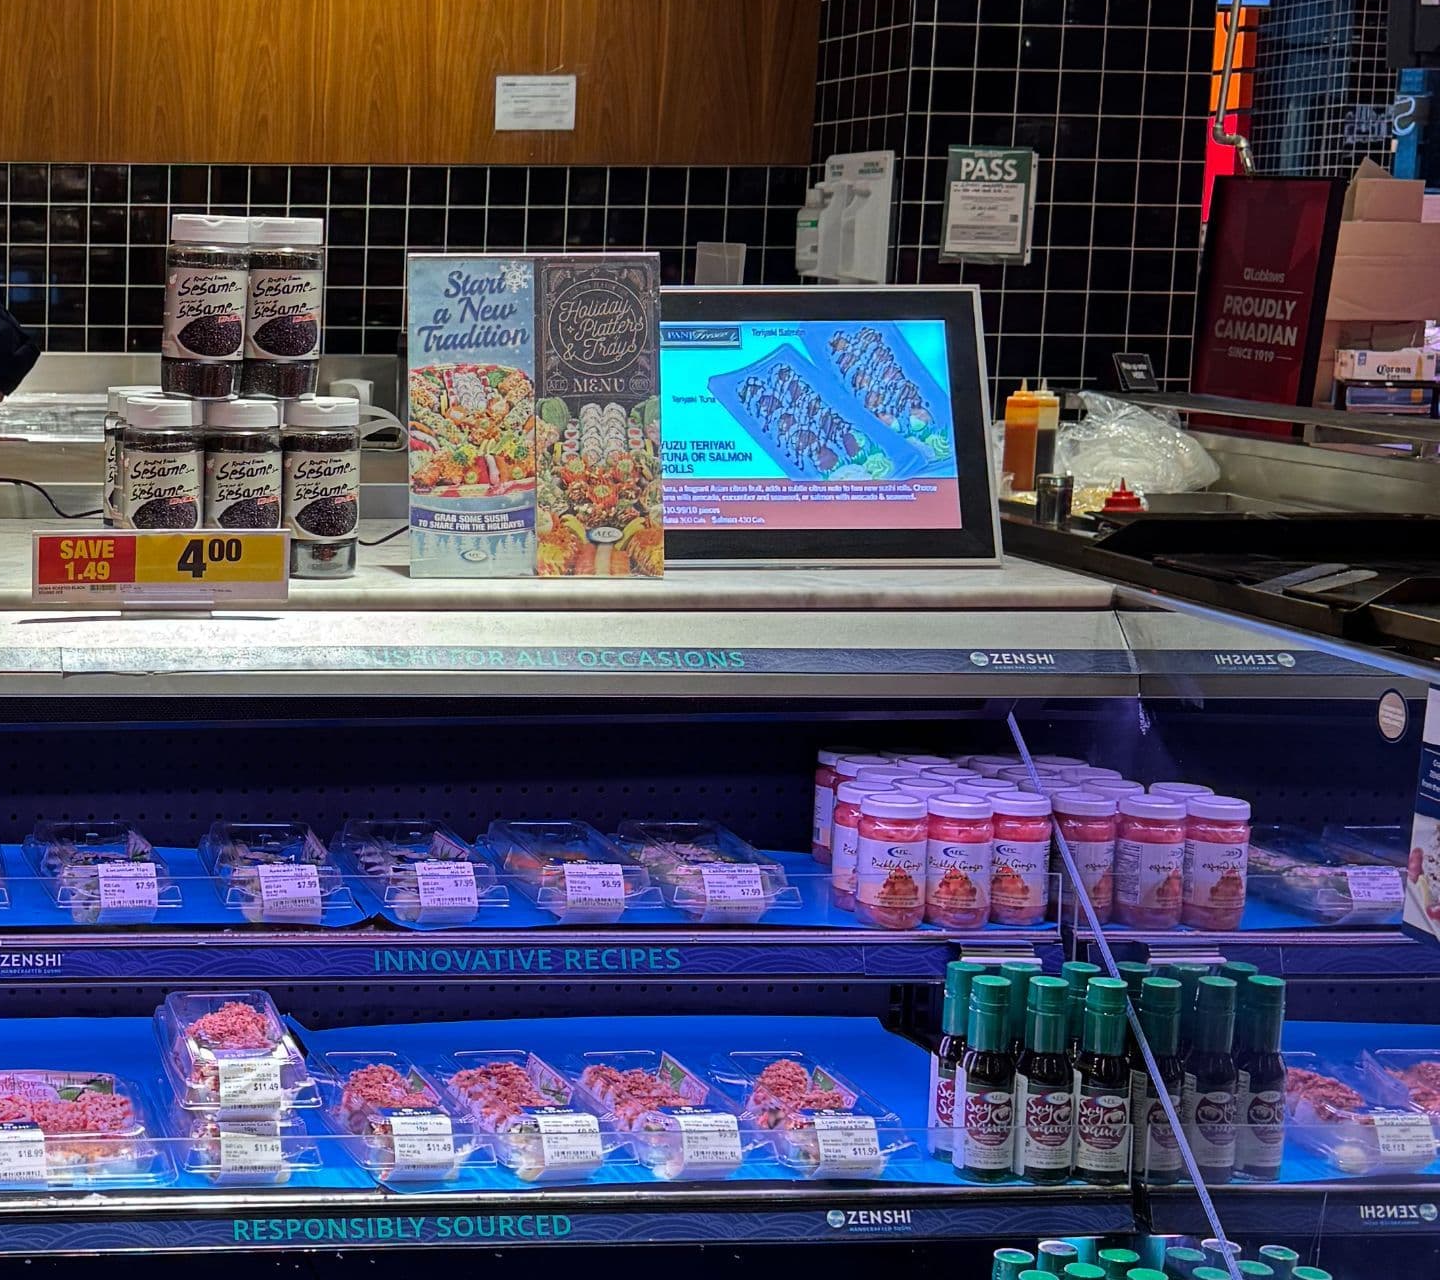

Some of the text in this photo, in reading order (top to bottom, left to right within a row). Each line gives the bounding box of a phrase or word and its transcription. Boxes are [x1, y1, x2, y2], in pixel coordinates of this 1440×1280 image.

[960, 157, 1018, 182] PASS
[177, 278, 234, 296] Sesame
[444, 270, 508, 299] Start
[433, 296, 517, 325] a New
[559, 299, 632, 323] Holiday
[1223, 295, 1297, 320] PROUDLY
[417, 324, 530, 354] Tradition
[574, 318, 644, 343] Platters
[1214, 320, 1298, 347] CANADIAN
[582, 339, 638, 364] Trays
[1228, 346, 1275, 363] SINCE 1919
[1376, 363, 1412, 376] Corona
[572, 376, 625, 393] MENU
[661, 440, 736, 451] YUZU TERIYAKI
[661, 452, 753, 463] TUNA OR SALMON
[661, 464, 694, 474] ROLLS
[429, 520, 455, 530] SHARE
[434, 513, 509, 523] GRAB SOME SUSHI
[60, 540, 114, 559] SAVE
[64, 562, 111, 580] 1.49
[450, 649, 505, 666] FOR
[516, 649, 568, 667] ALL
[576, 649, 747, 669] OCCASIONS
[989, 652, 1055, 666] ZENSHI
[135, 881, 155, 890] $7.99
[0, 952, 64, 968] ZENSHI
[373, 947, 682, 973] INNOVATIVE RECIPES
[253, 1082, 279, 1092] $11.49
[1079, 1098, 1104, 1124] Soy
[17, 1148, 44, 1159] $18.99
[427, 1143, 452, 1153] $11.49
[852, 1146, 878, 1157] $11.99
[847, 1210, 911, 1226] ZENSHI
[232, 1214, 572, 1242] RESPONSIBLY SOURCED
